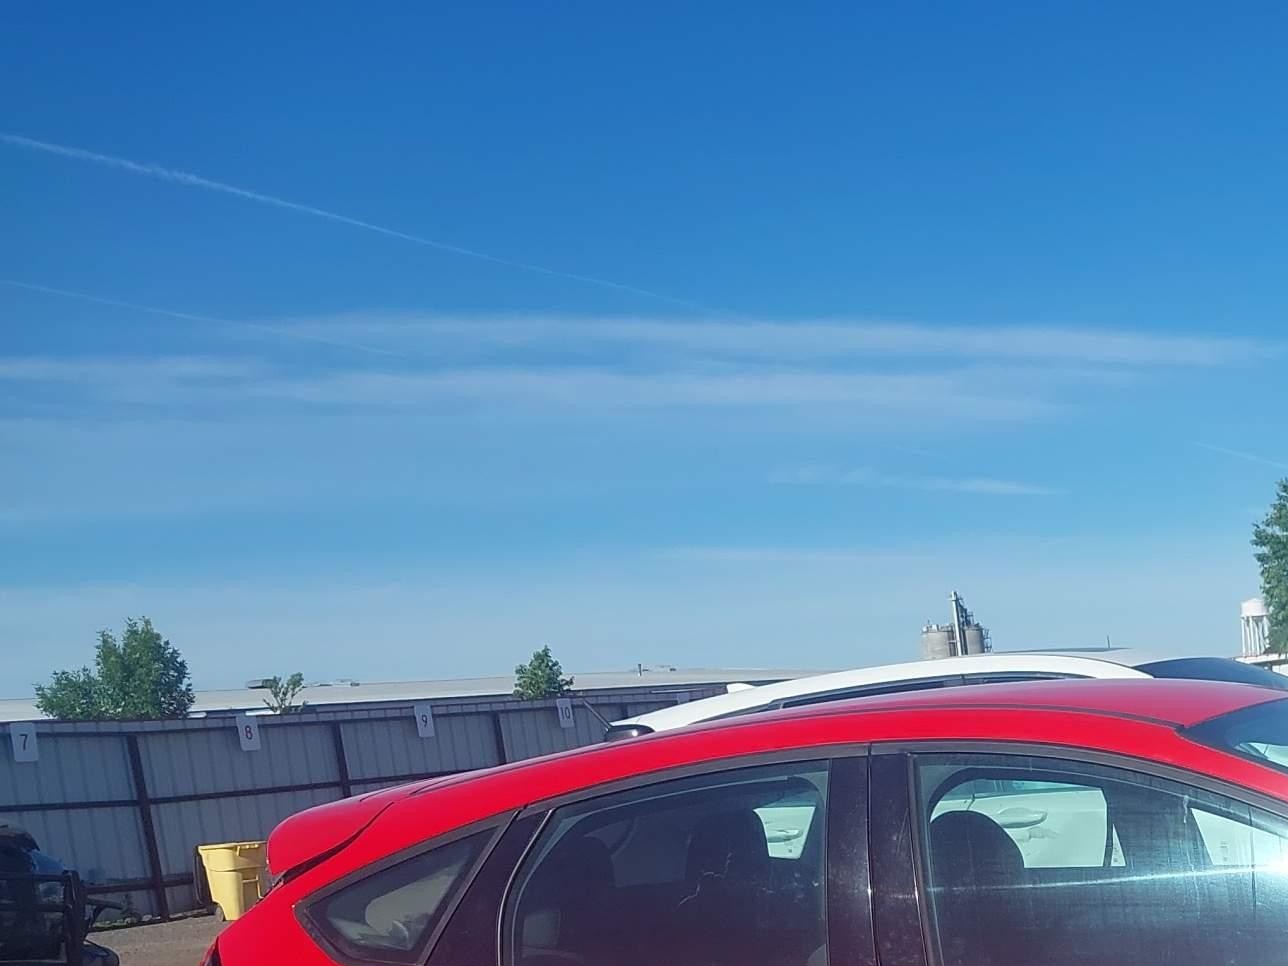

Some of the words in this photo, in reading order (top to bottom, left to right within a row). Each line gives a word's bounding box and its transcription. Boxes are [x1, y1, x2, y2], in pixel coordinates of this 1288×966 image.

[421, 713, 428, 728] 9
[560, 706, 571, 720] 10
[244, 725, 254, 741] 8
[19, 733, 29, 751] 7
